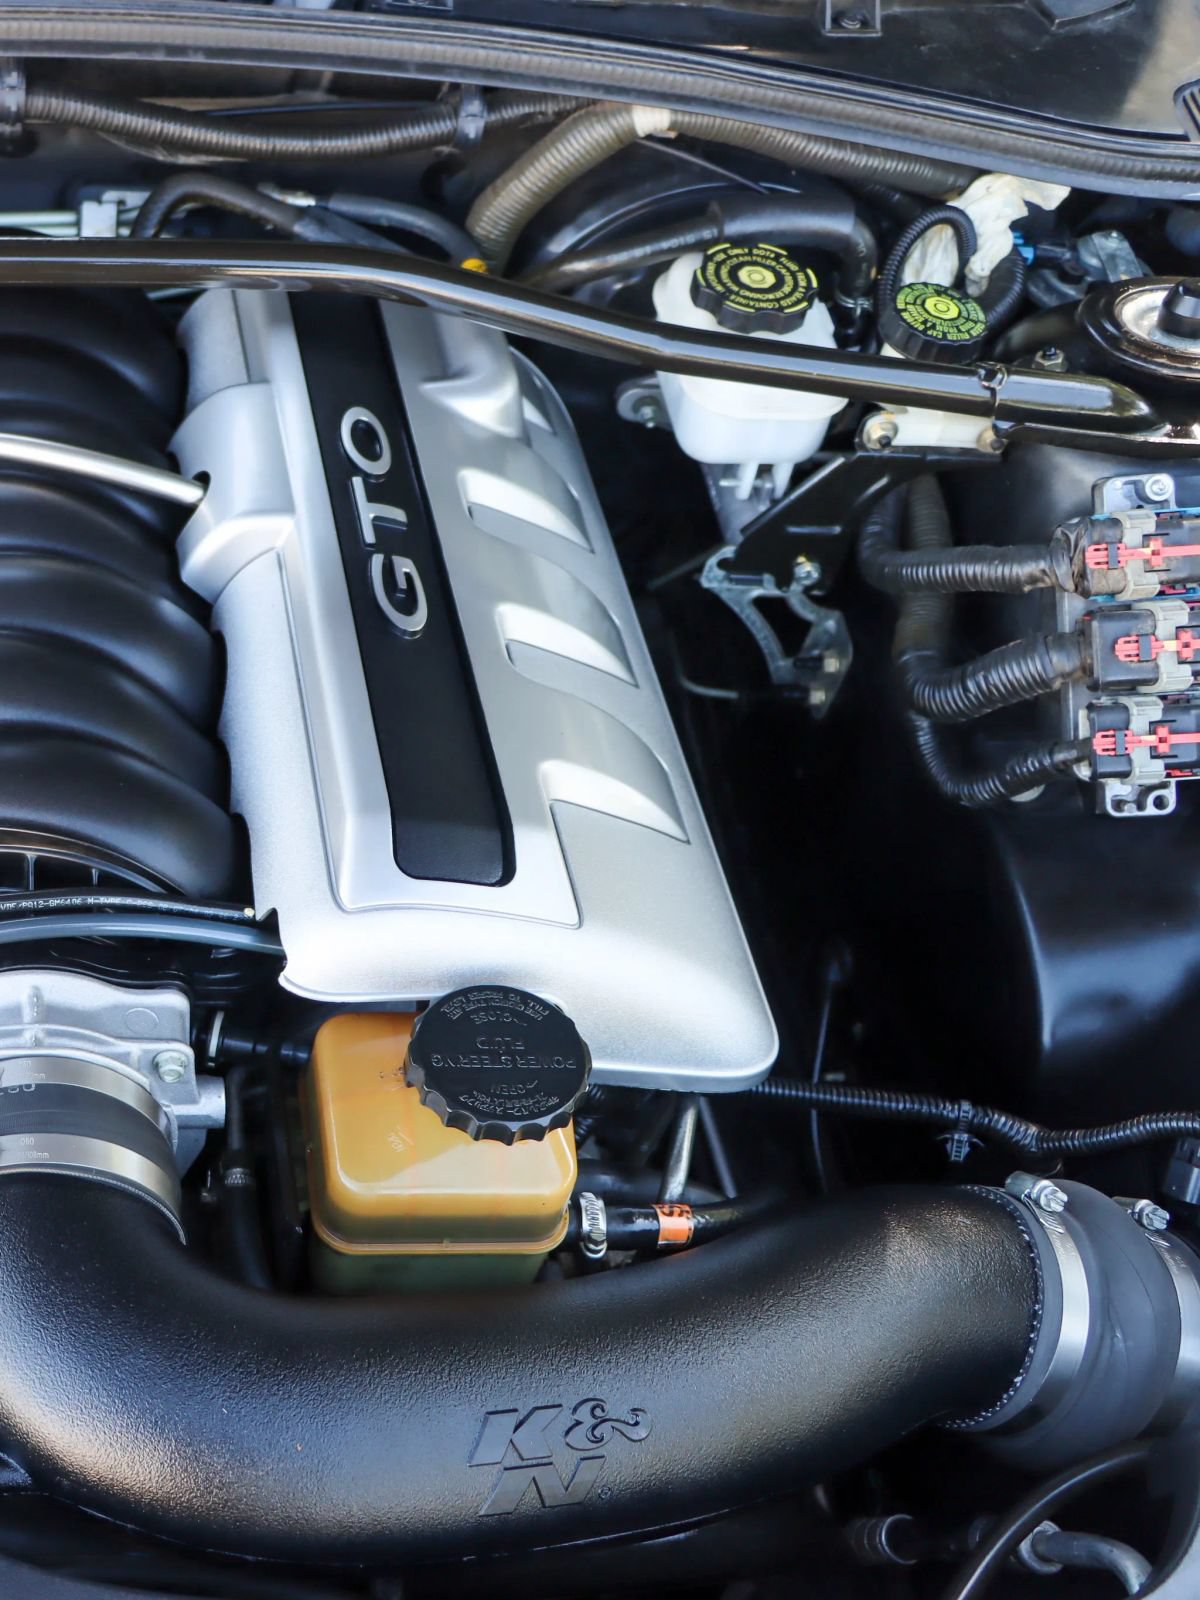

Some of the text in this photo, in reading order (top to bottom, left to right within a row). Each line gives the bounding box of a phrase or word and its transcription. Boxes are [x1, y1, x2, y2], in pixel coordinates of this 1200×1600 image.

[341, 406, 428, 634] GTO
[470, 1011, 513, 1025] CLOSE
[475, 1037, 526, 1051] FLUID
[431, 1054, 577, 1069] POWER STEERING
[490, 1083, 526, 1095] OPEN
